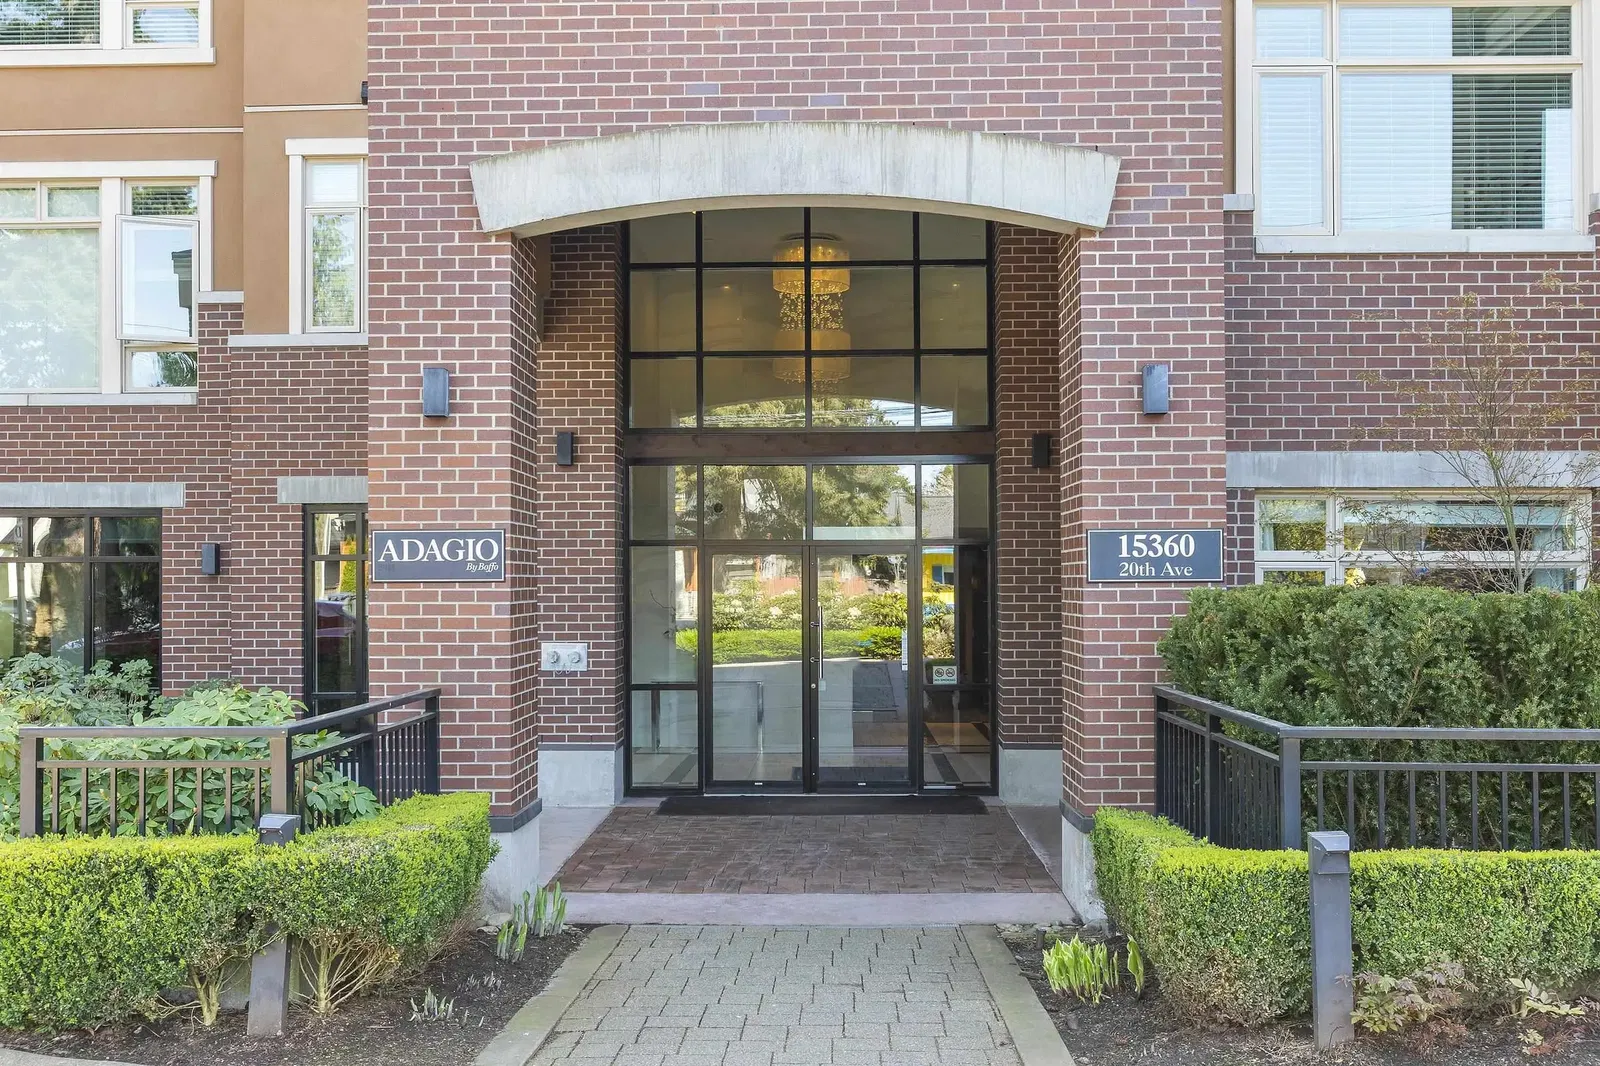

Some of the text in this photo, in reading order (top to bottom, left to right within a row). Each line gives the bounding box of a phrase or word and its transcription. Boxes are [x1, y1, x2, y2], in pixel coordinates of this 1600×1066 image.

[378, 538, 499, 562] ADAGIO
[1118, 533, 1195, 558] 15360
[465, 562, 499, 573] By Boffo
[1119, 561, 1193, 577] 20th Ave
